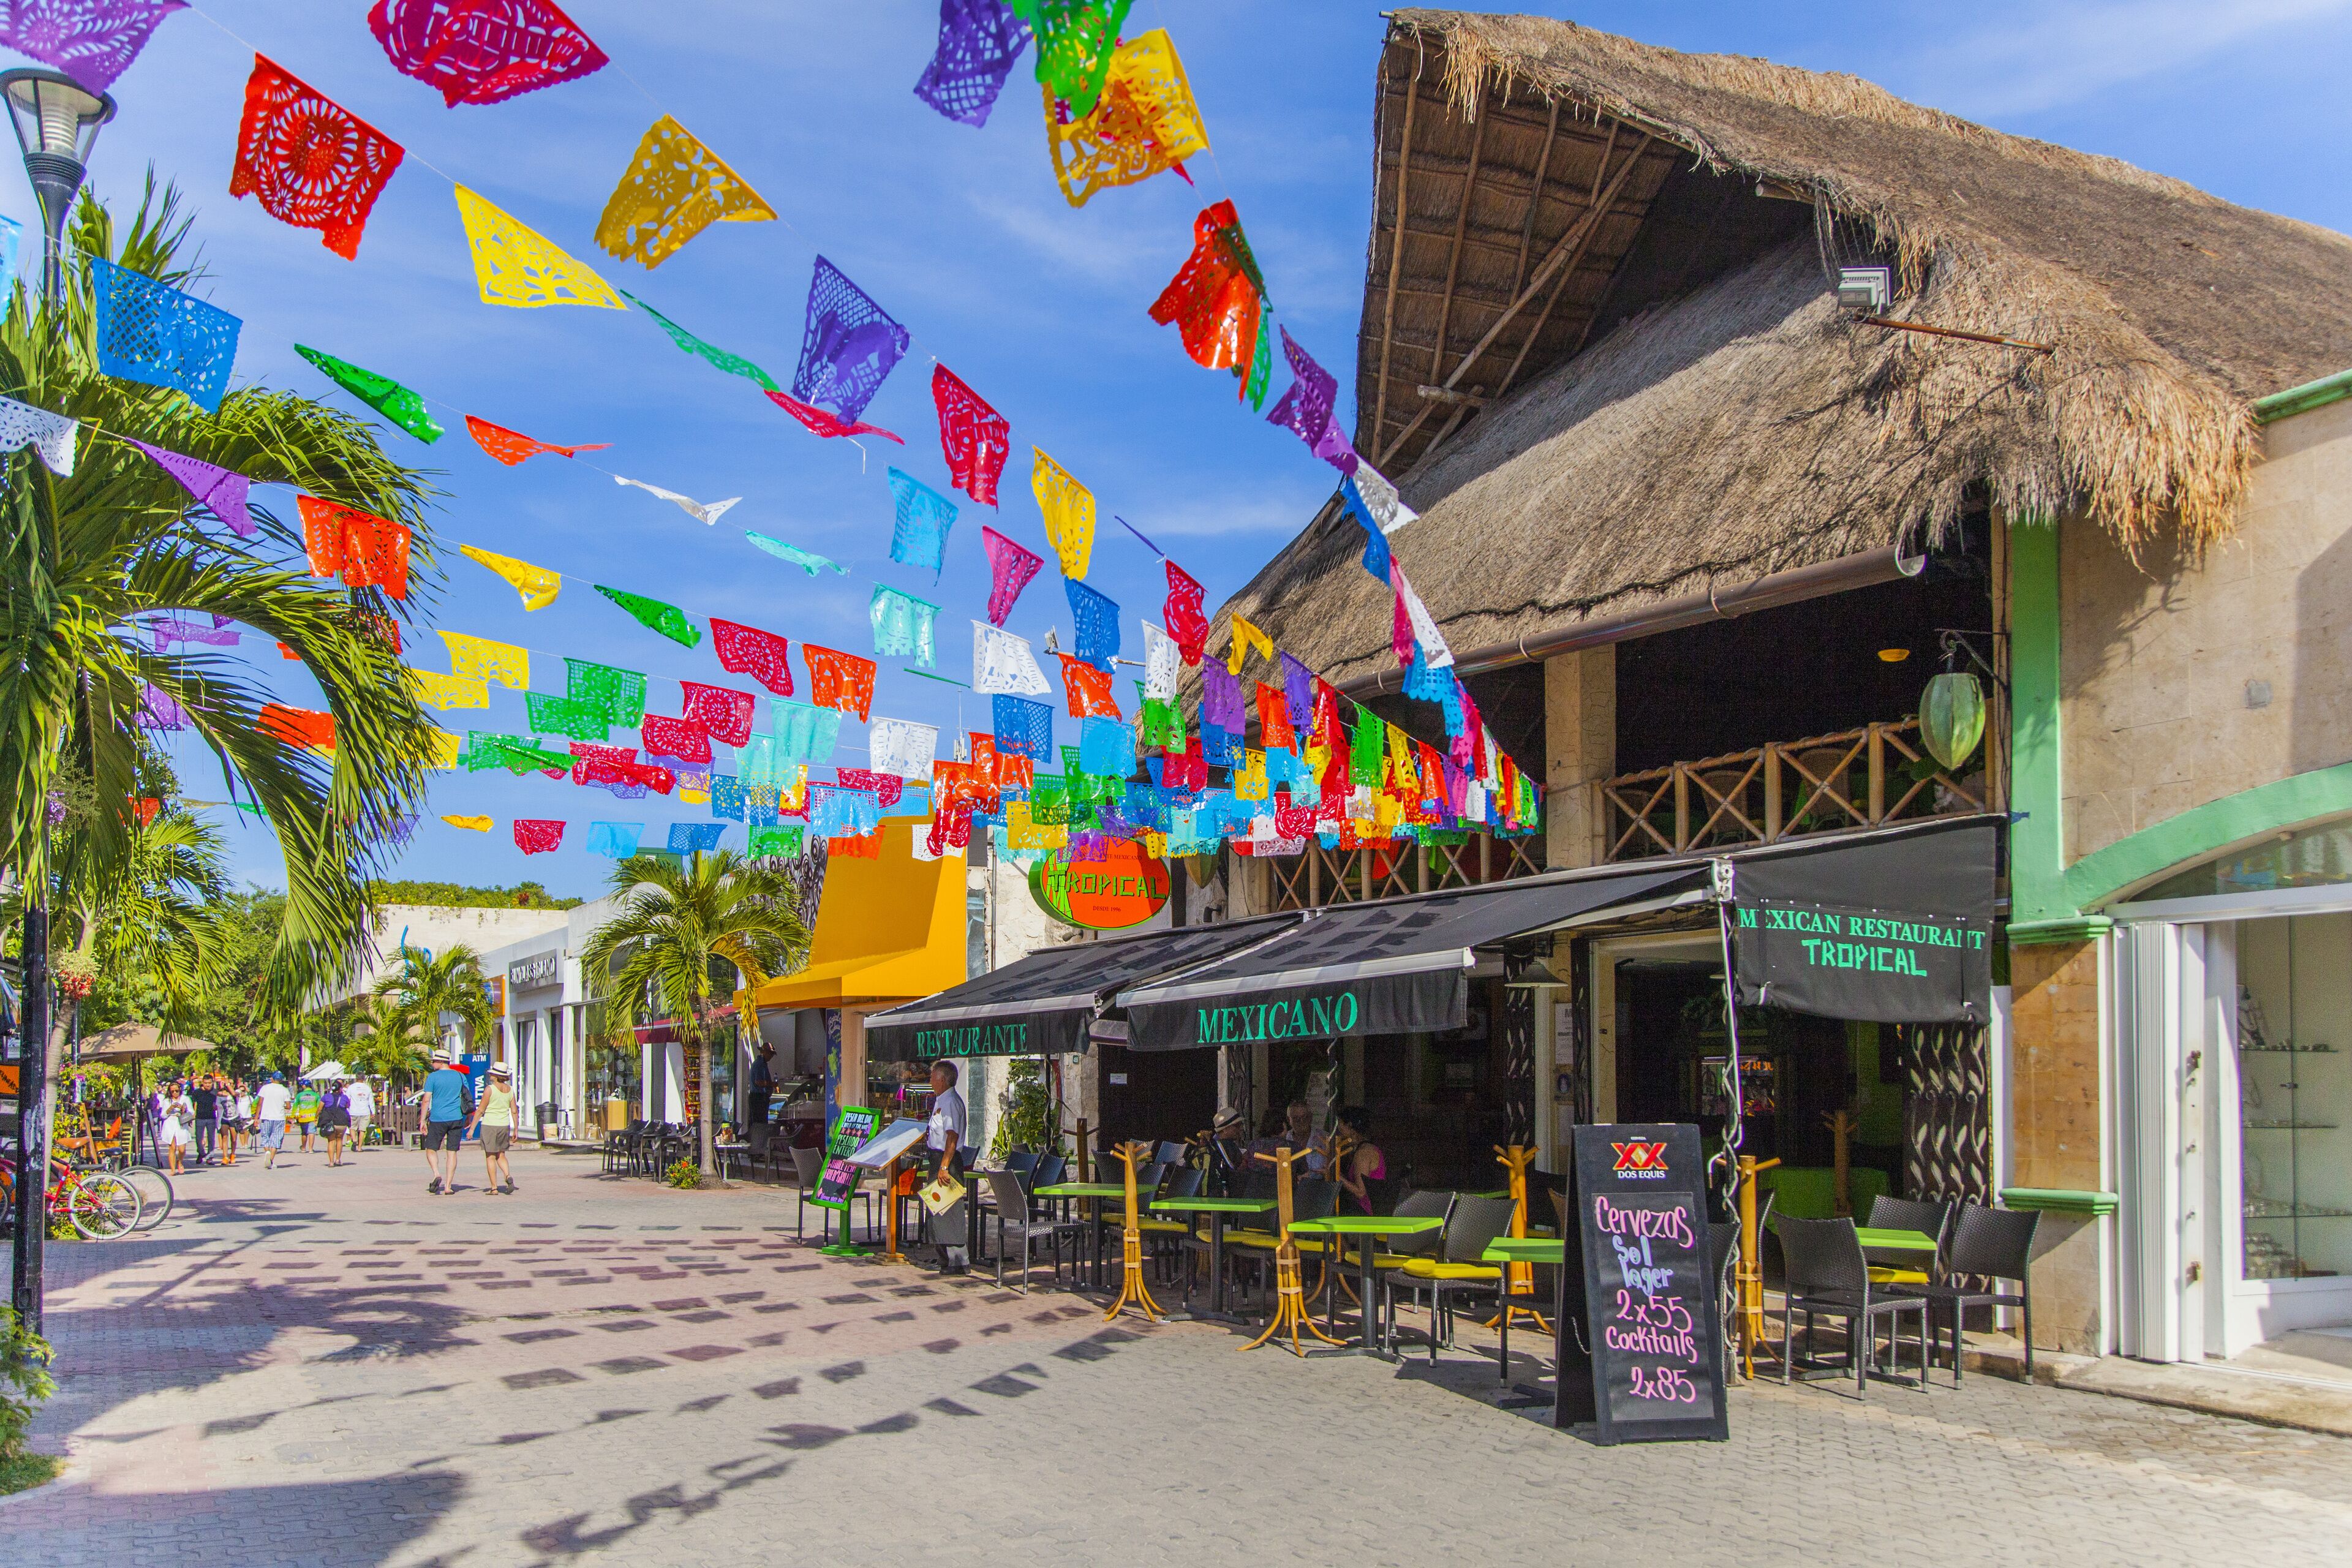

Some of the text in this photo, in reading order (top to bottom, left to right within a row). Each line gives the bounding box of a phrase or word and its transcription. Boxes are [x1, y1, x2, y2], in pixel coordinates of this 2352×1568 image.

[1047, 870, 1167, 899] TROPICAL
[1801, 938, 1928, 978] TROPICAL
[1197, 992, 1359, 1043] MEXICANO
[916, 1023, 1028, 1058] RESTAURANTE
[832, 1144, 855, 1158] ENTERO
[835, 1134, 859, 1148] PESCADO
[1610, 1142, 1669, 1170] XX
[1617, 1170, 1666, 1180] DOS EQUIS
[1596, 1196, 1695, 1248] Cervezas
[1612, 1234, 1653, 1267] Sol
[1616, 1289, 1693, 1333] 2x55
[1605, 1325, 1698, 1364] Cocktails
[1629, 1366, 1697, 1403] 2x85
